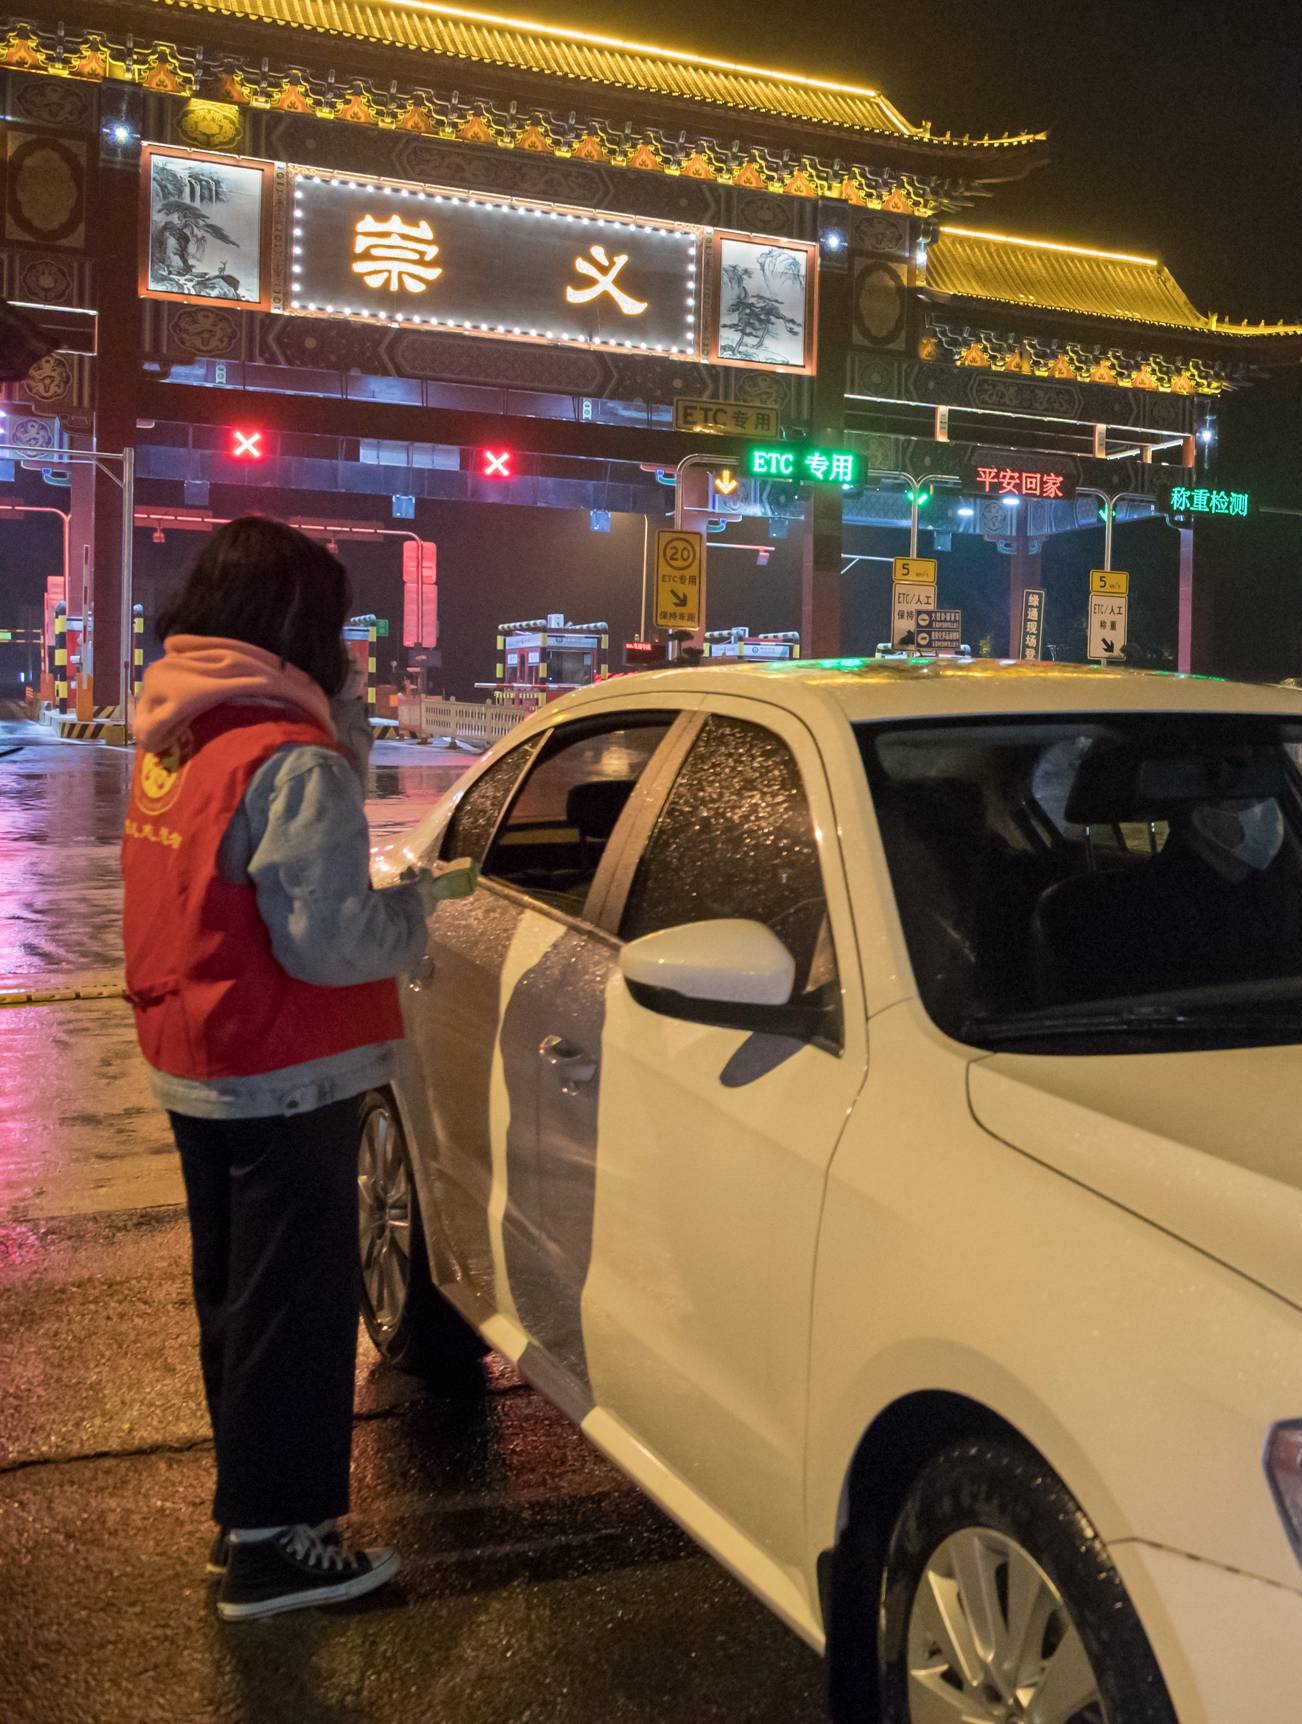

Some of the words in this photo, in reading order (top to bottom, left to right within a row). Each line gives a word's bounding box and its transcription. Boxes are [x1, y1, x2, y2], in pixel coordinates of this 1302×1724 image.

[351, 213, 649, 315] 崇义
[683, 405, 728, 427] ETC
[732, 410, 771, 432] 专用
[753, 451, 794, 475] ETC
[804, 451, 854, 482] 专用
[976, 466, 1064, 498] 平安回家
[1170, 486, 1249, 517] 称重检测
[669, 546, 690, 562] 20
[901, 563, 910, 576] 5
[1099, 576, 1107, 588] 5
[897, 592, 932, 606] ETC/人工
[1093, 603, 1123, 616] ETC/人工
